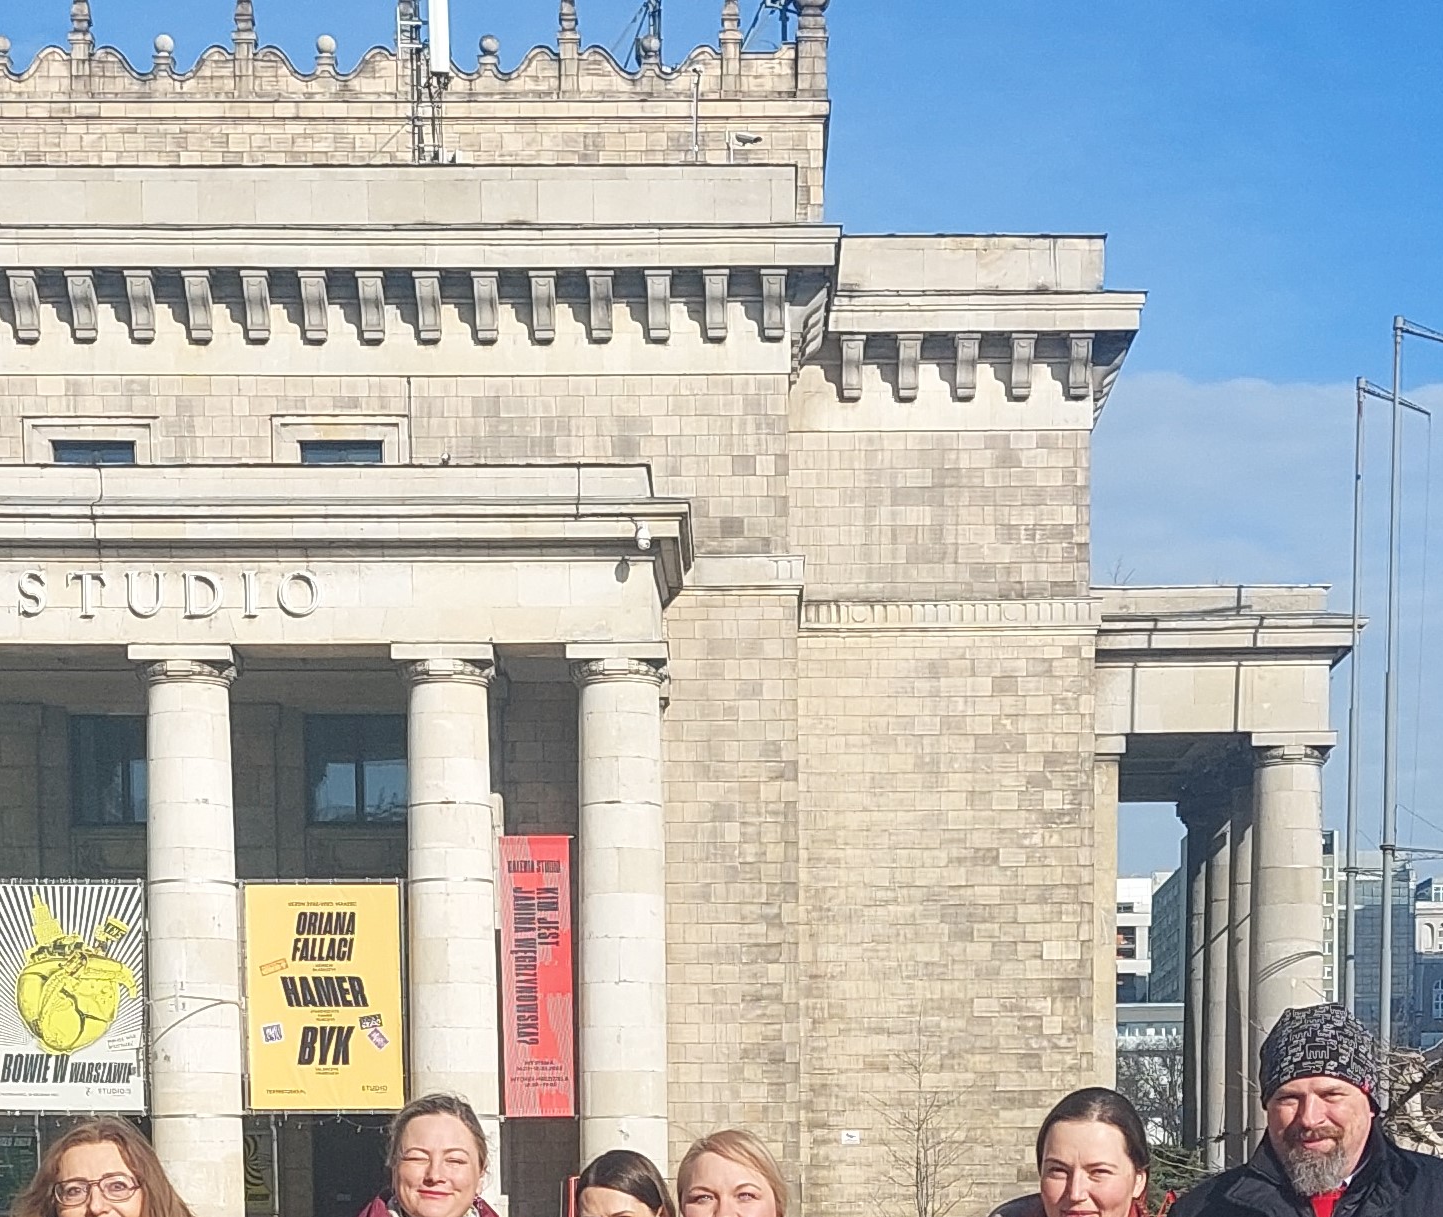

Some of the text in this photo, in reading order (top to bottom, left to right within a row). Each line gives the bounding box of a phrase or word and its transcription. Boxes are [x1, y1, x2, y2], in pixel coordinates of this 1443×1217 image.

[17, 567, 325, 620] STUDIO
[536, 860, 561, 873] STUDIO
[295, 911, 356, 936] ORIANA
[536, 886, 560, 947] KIM JEST
[291, 937, 355, 962] FALLACI
[510, 886, 539, 1046] JANINA WĘGRZYNOWSKA?
[280, 976, 369, 1007] HAMER
[297, 1025, 356, 1066] BYK
[0, 1053, 134, 1084] BOWIE W WARSZAWIE
